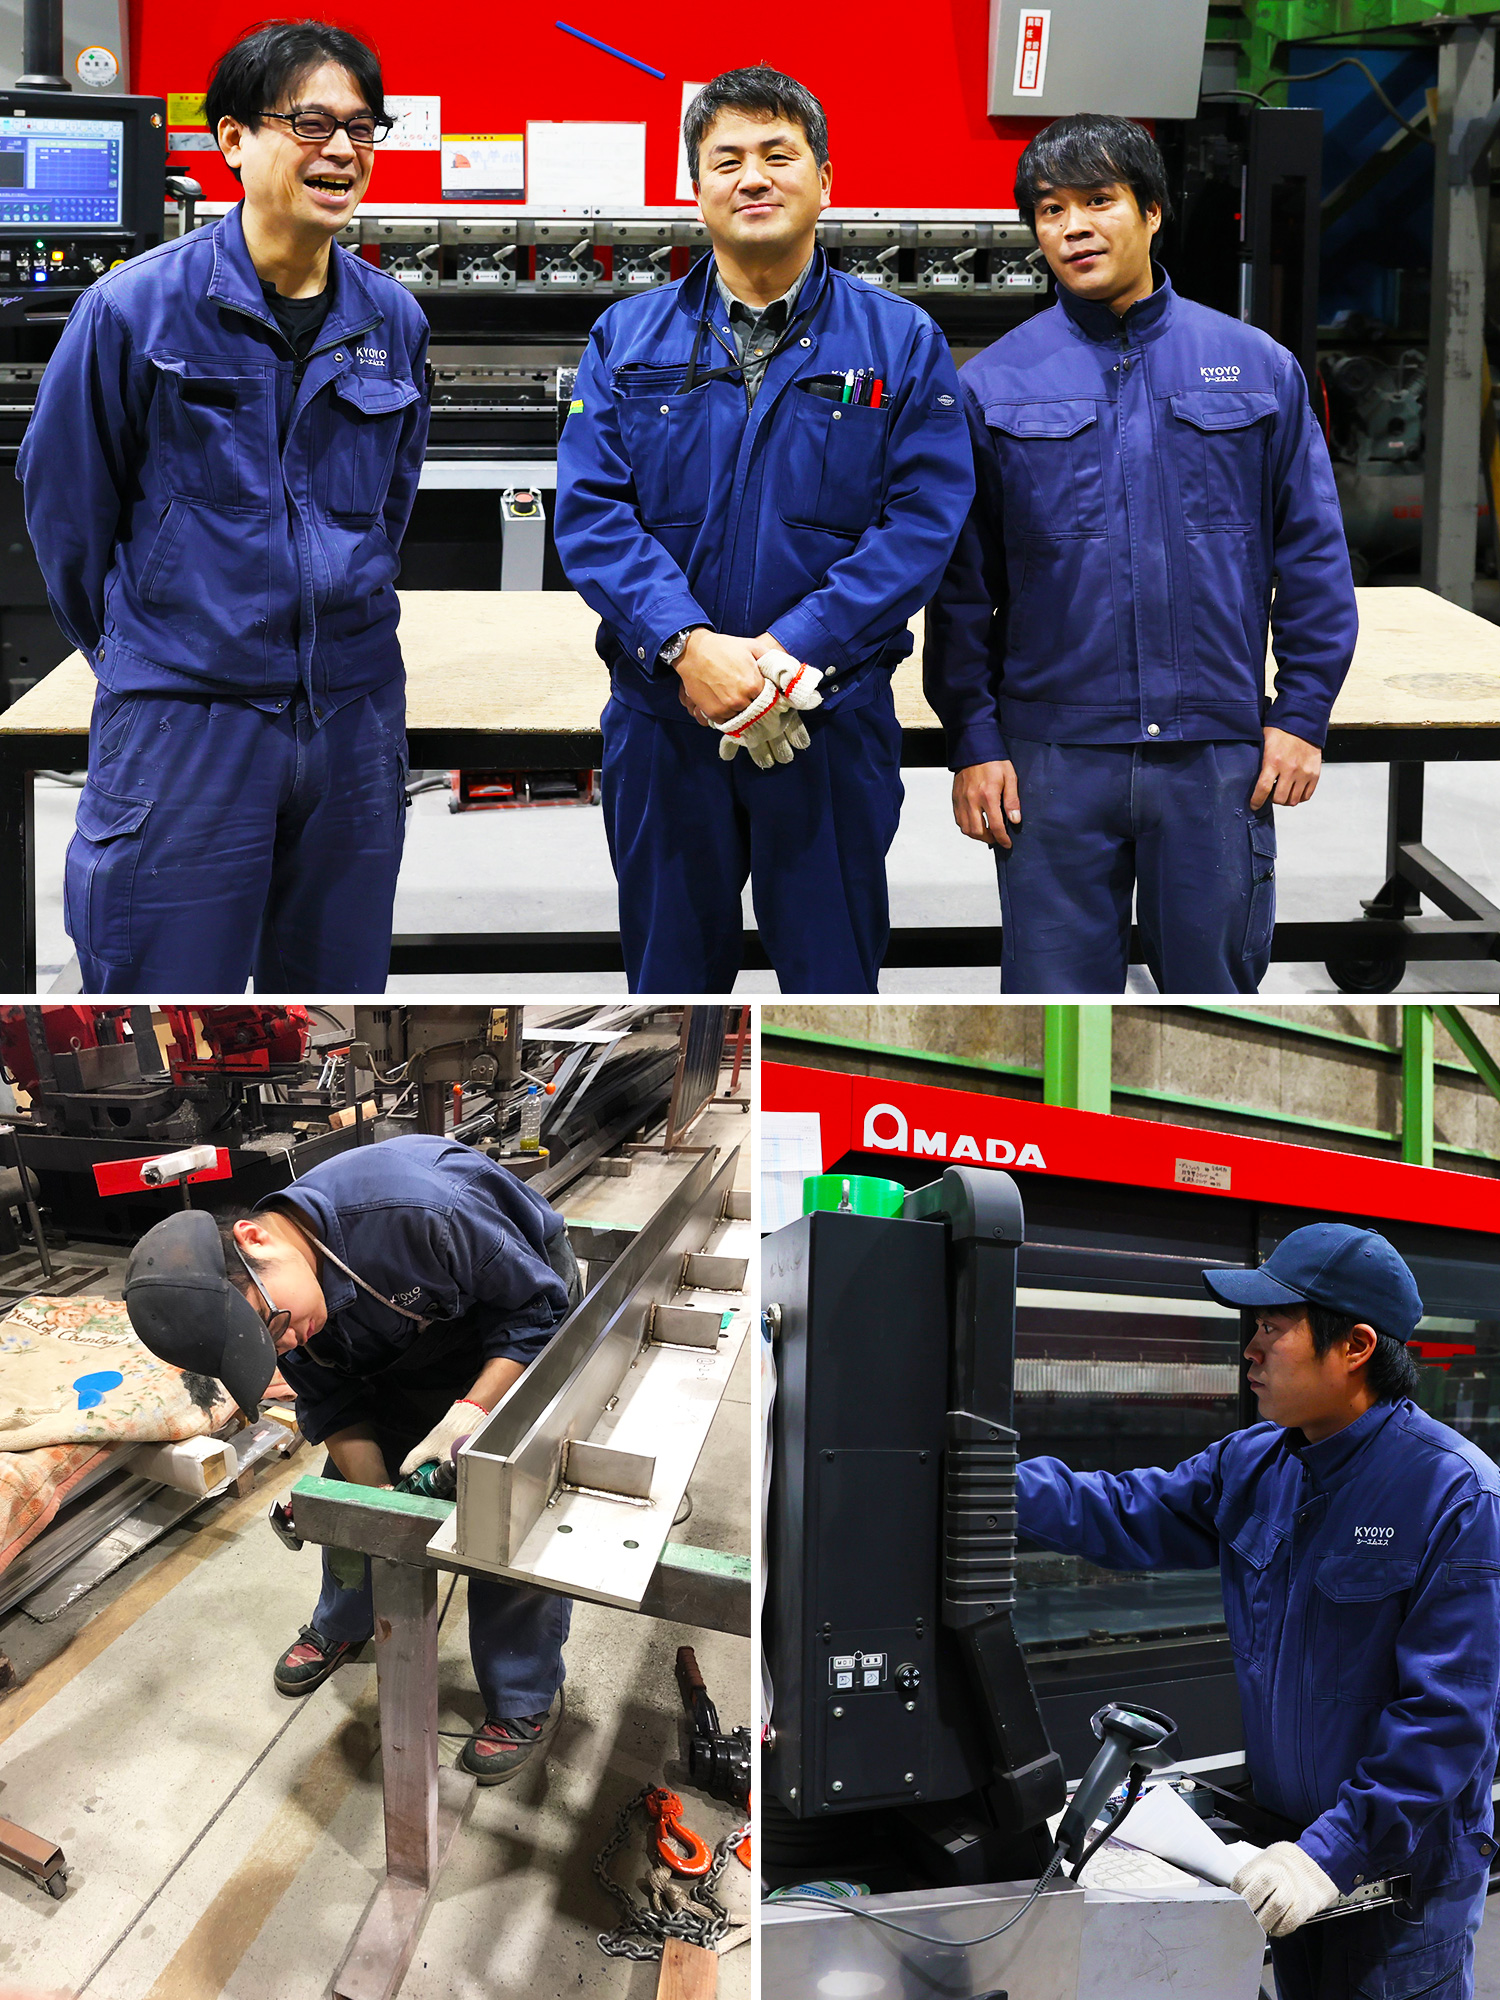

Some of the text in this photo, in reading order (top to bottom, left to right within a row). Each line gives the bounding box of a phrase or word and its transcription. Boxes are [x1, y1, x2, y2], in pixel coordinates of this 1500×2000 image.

[356, 347, 387, 360] KYOYO
[1199, 365, 1241, 376] KYOYO
[863, 1103, 1047, 1169] AMADA
[390, 1286, 421, 1304] KYOYO
[1354, 1526, 1395, 1538] KYOYO
[1356, 1538, 1389, 1546] シーエムエス
